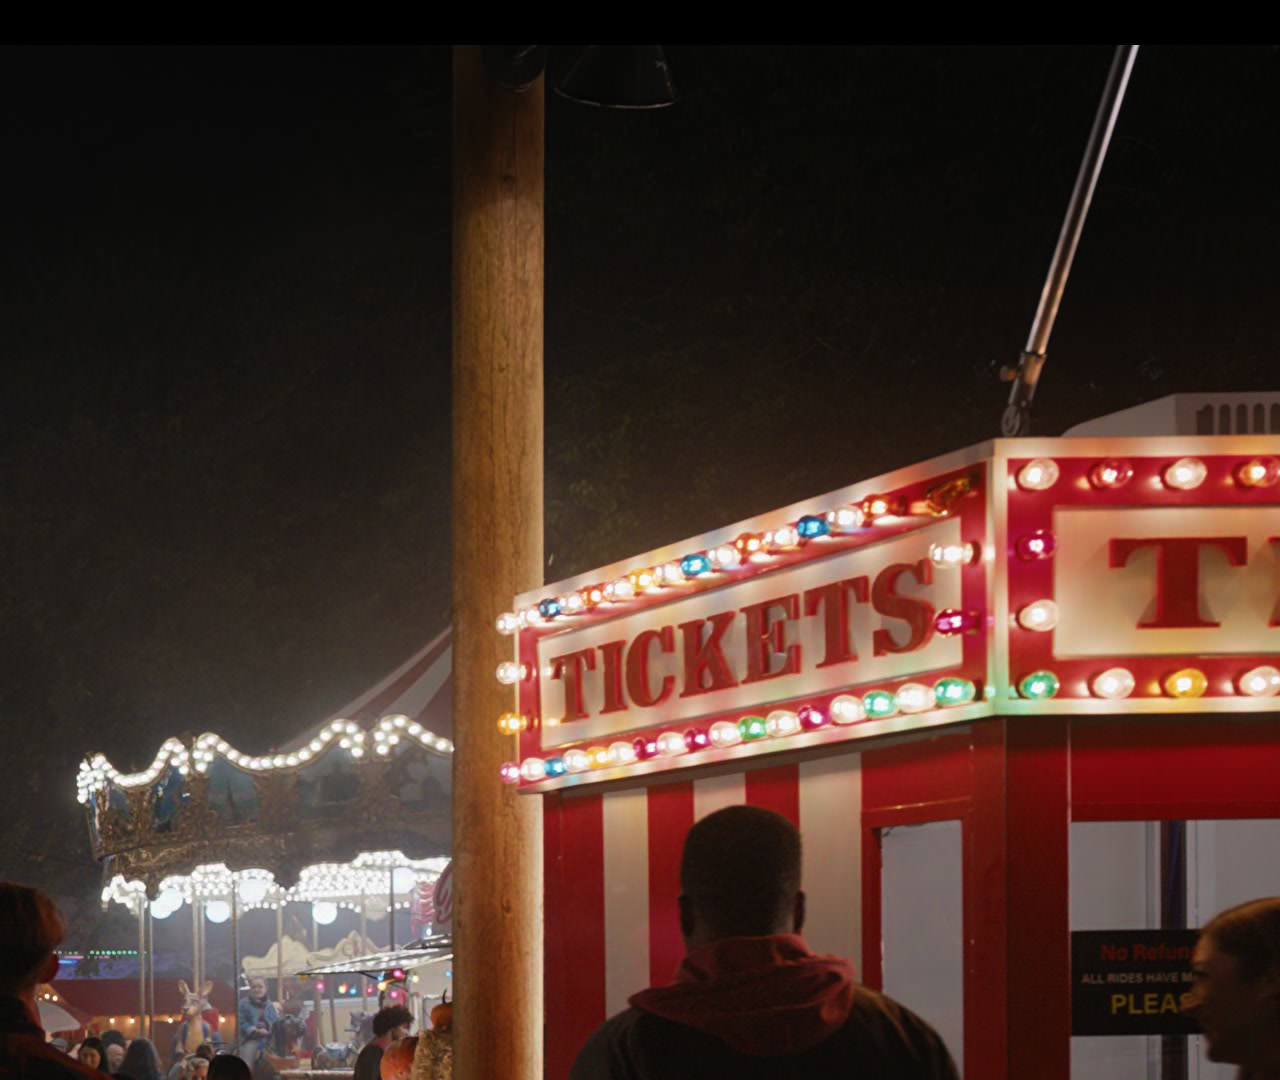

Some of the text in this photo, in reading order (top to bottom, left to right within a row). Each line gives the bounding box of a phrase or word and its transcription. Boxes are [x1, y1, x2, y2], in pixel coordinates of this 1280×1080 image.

[1109, 536, 1280, 630] T
[550, 558, 936, 723] TICKETS
[1081, 972, 1104, 984] ALL
[1107, 972, 1144, 984] RIDES
[1146, 971, 1178, 984] HAVE
[1100, 943, 1194, 960] No Refun
